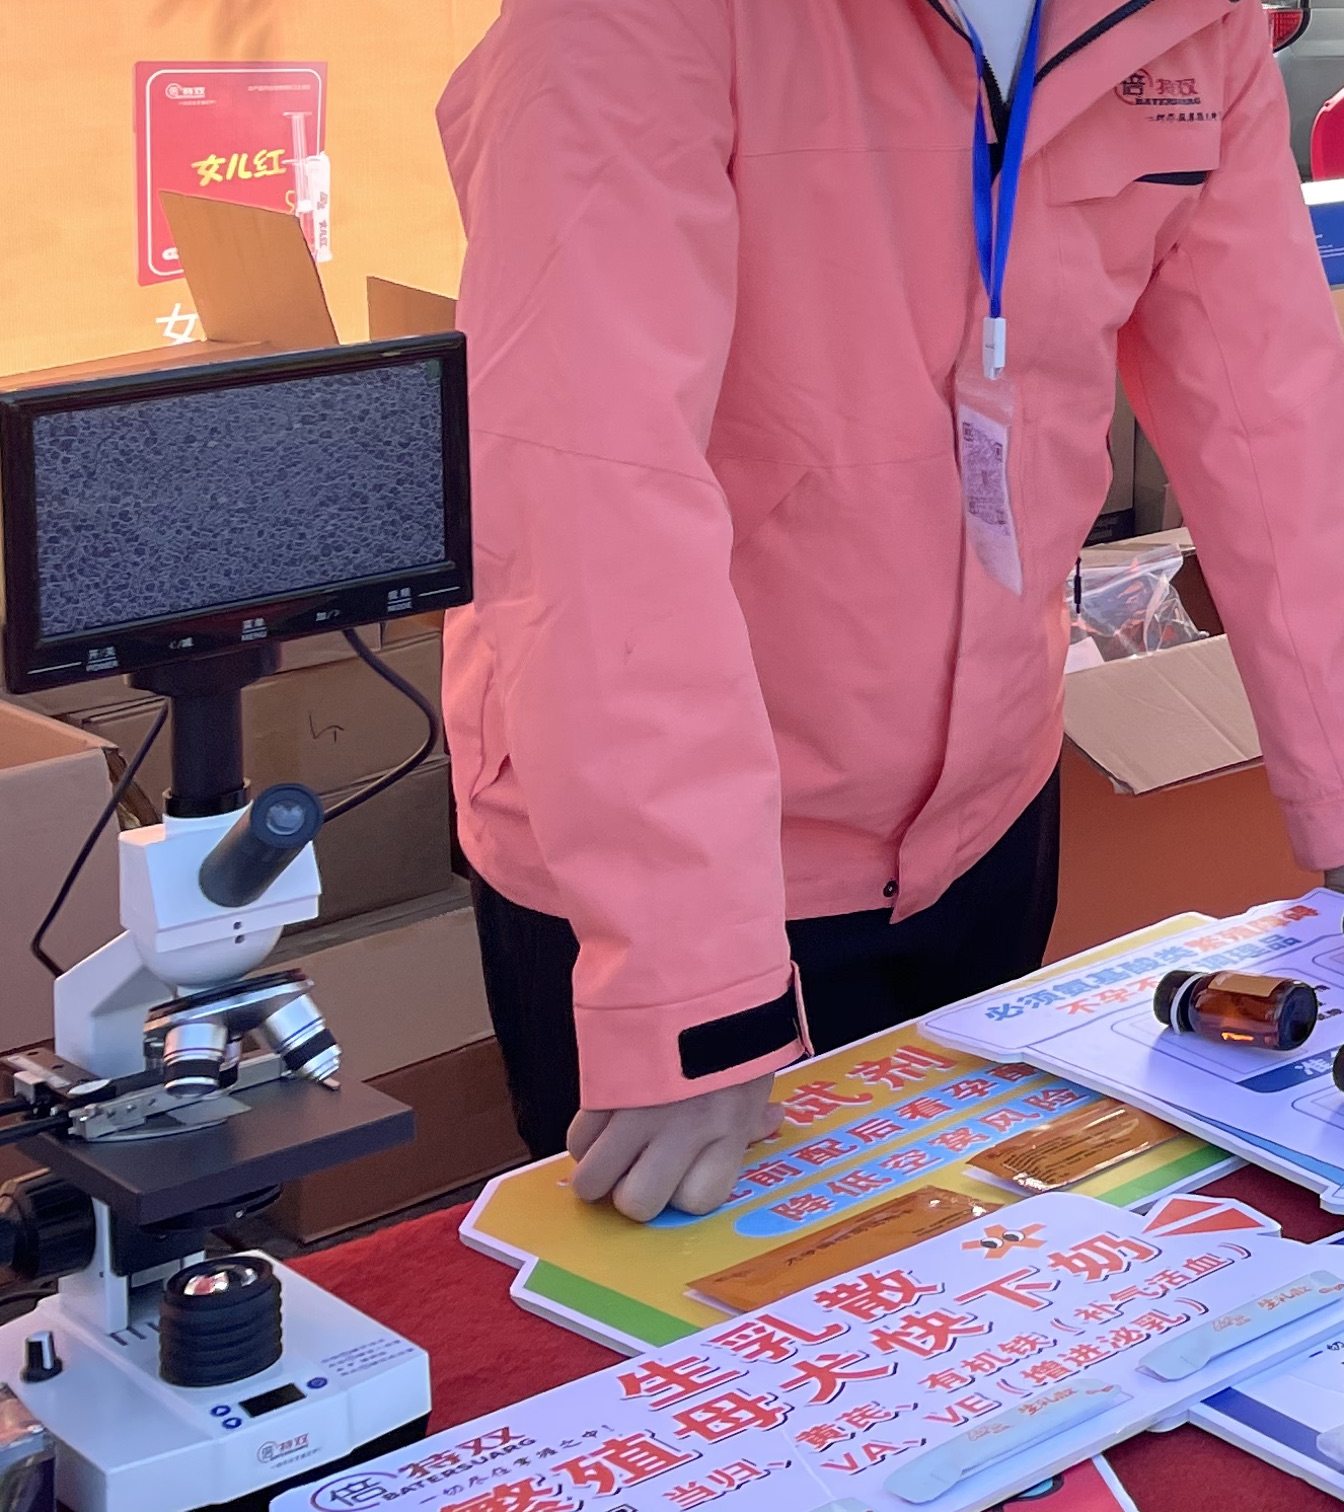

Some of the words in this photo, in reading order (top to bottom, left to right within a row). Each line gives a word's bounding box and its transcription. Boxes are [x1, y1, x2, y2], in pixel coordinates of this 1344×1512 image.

[191, 148, 287, 186] 女儿红
[748, 1044, 959, 1145] 试剂
[768, 1087, 1088, 1224] 降低空窝风险
[616, 1264, 945, 1412] 生乳散
[329, 1476, 388, 1507] 倍
[399, 1426, 526, 1479] 特双
